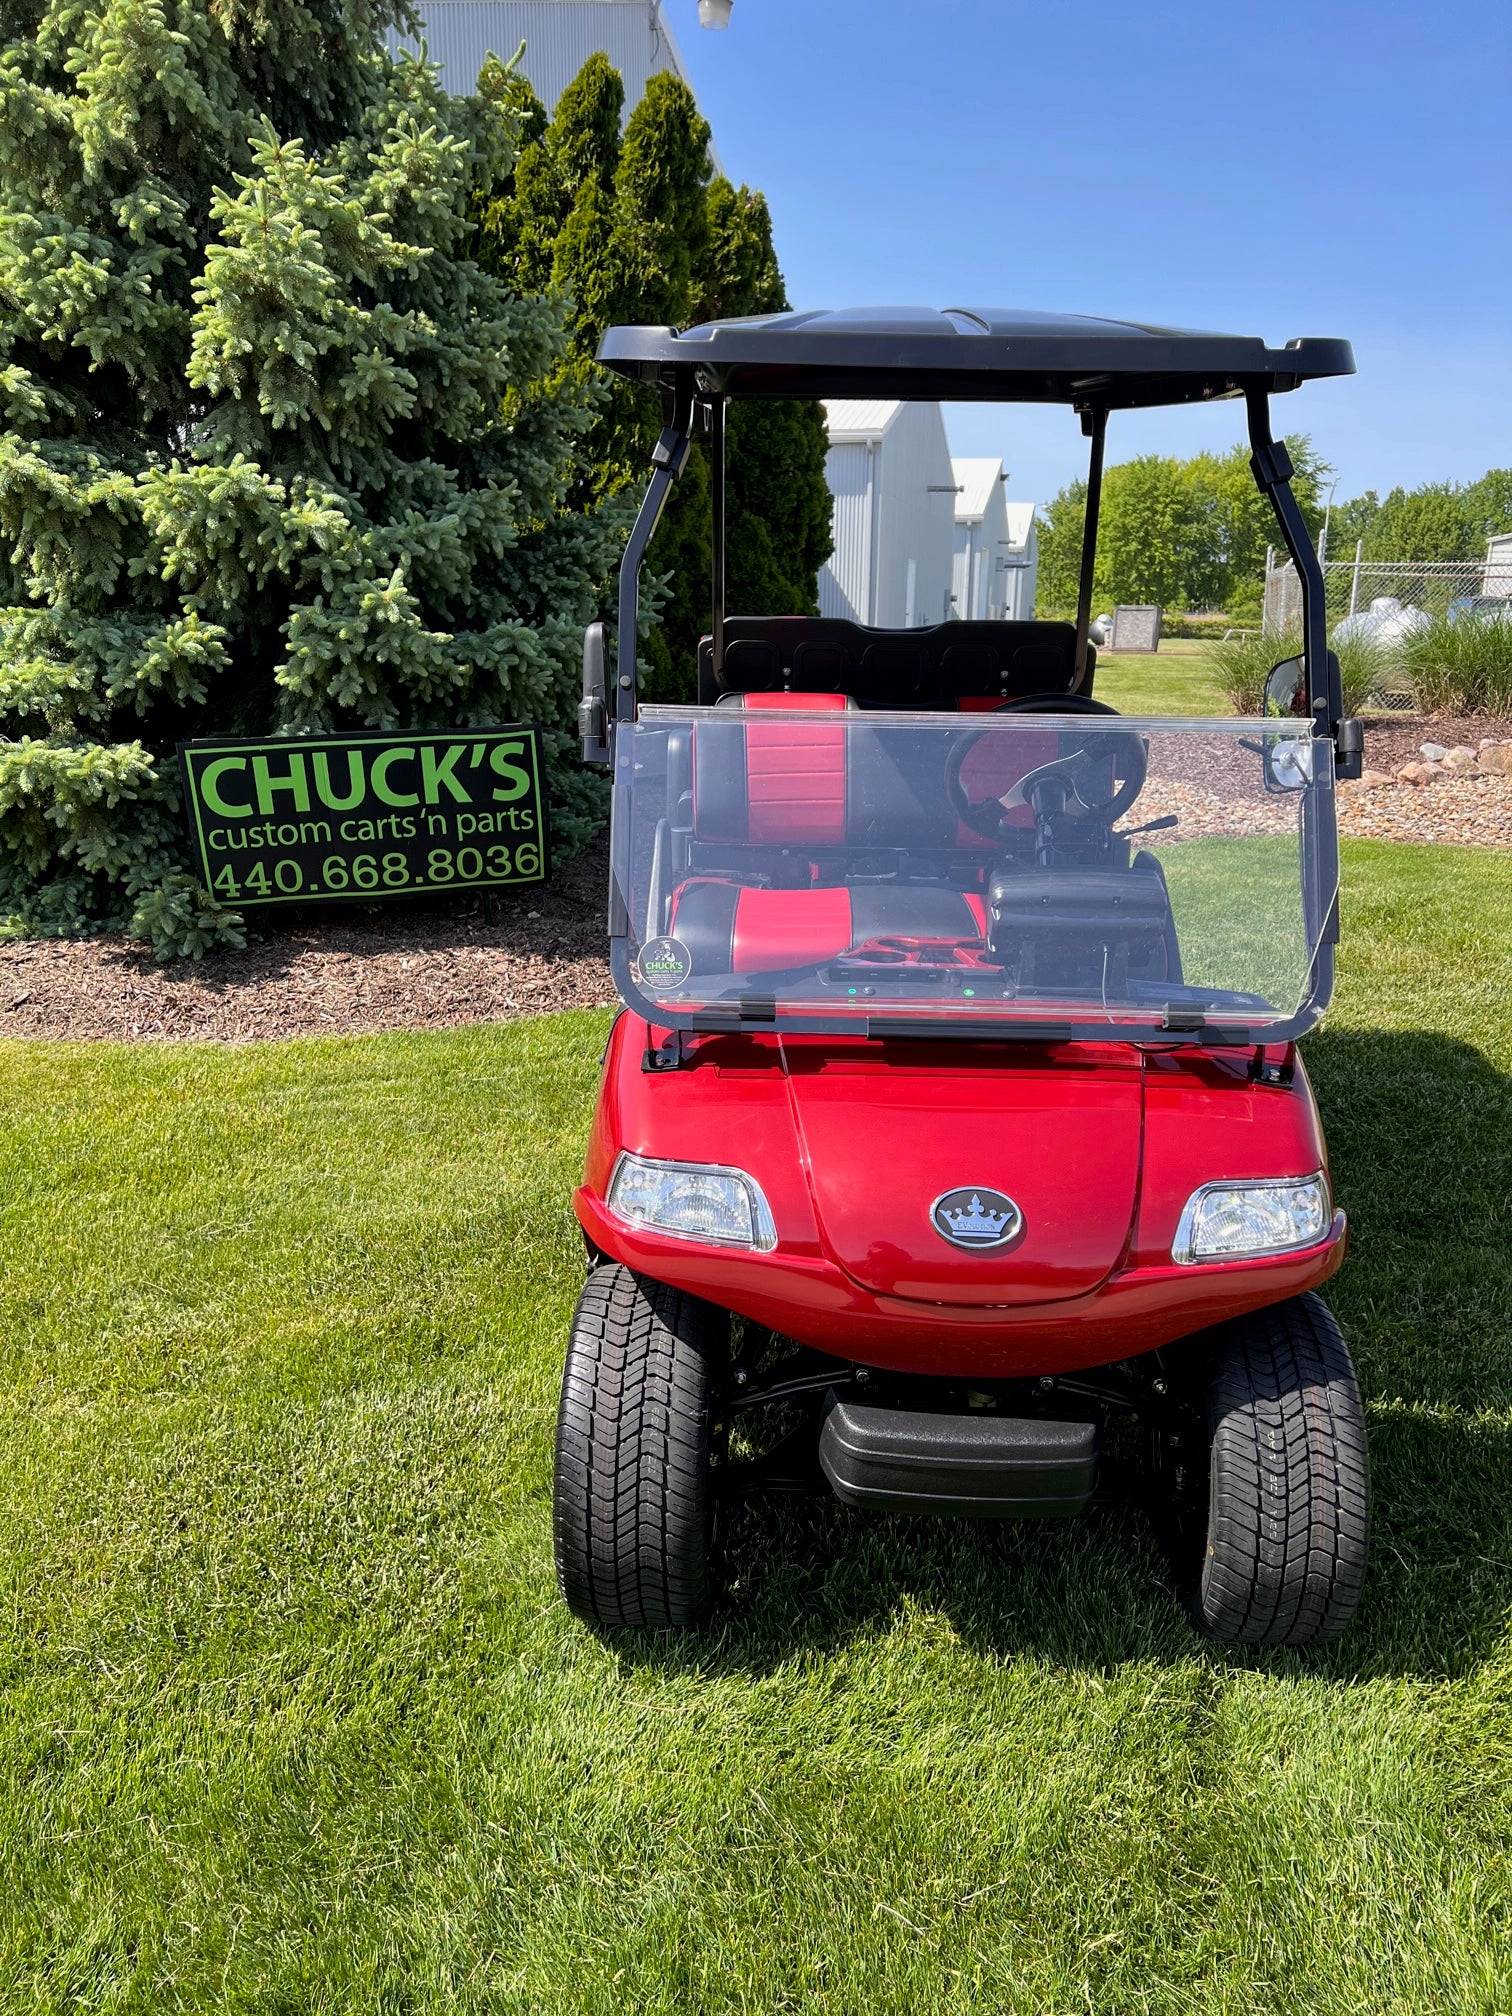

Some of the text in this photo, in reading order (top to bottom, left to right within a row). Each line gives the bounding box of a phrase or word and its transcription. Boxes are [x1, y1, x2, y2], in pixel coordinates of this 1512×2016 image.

[200, 741, 531, 818] CHUCK'S
[208, 821, 332, 851] custom
[339, 814, 417, 842] carts
[456, 807, 534, 842] parts
[213, 842, 540, 898] 440.668.8036
[645, 961, 683, 970] CHUCK'S
